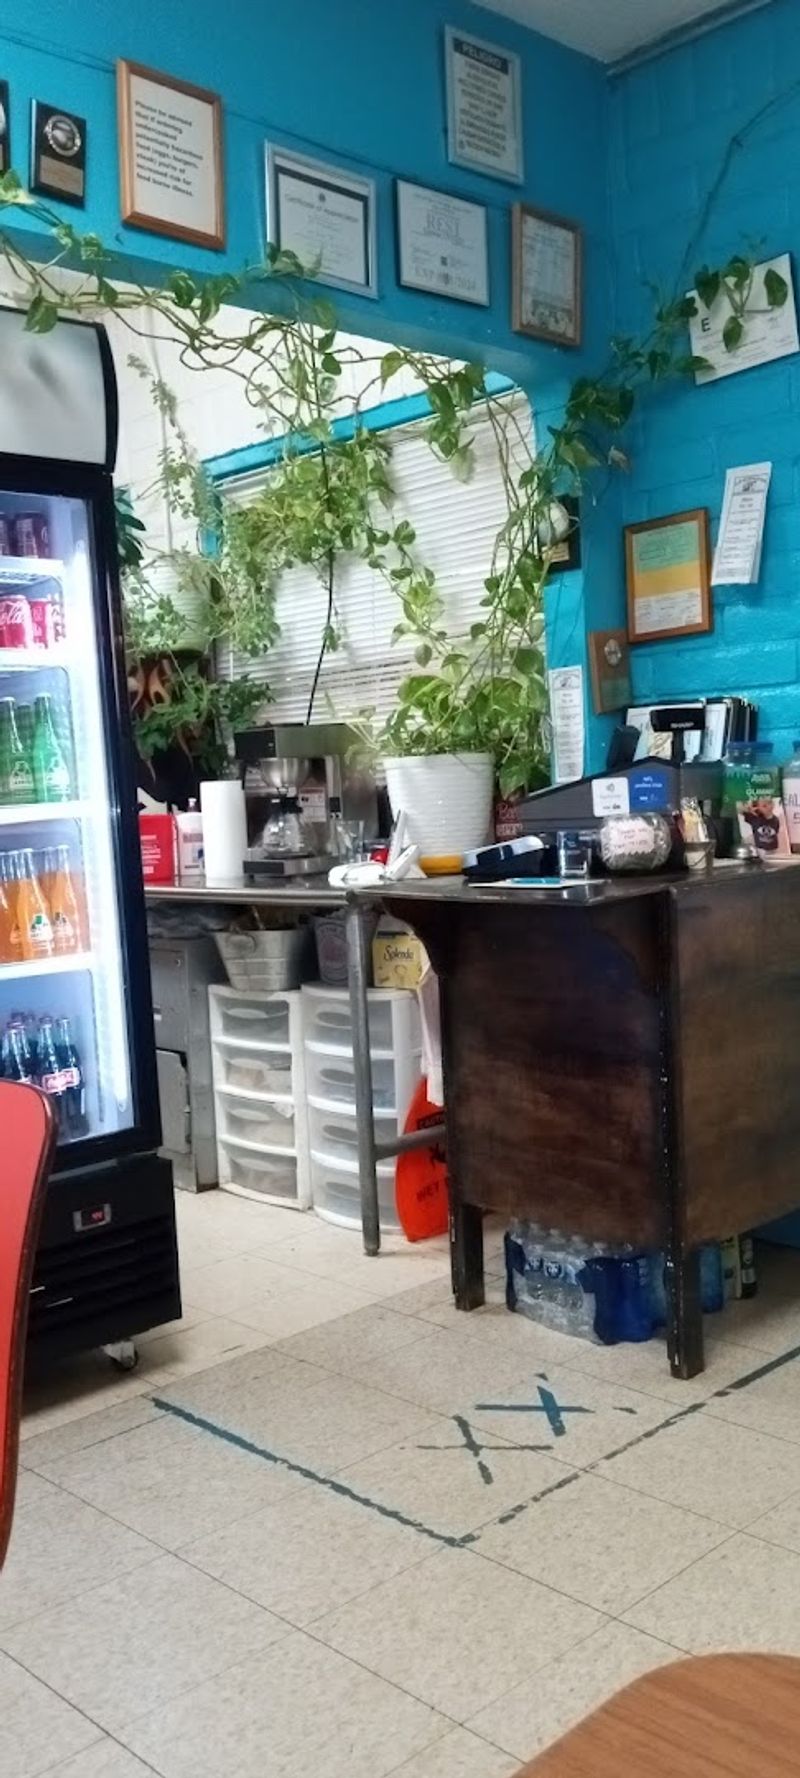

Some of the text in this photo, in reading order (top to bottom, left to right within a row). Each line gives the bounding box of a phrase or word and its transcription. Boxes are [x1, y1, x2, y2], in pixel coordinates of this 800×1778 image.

[135, 100, 157, 113] Please
[158, 109, 167, 117] be
[135, 111, 149, 120] that
[136, 142, 150, 152] food
[136, 171, 151, 182] food
[169, 174, 181, 182] risk
[383, 944, 415, 962] Splenda
